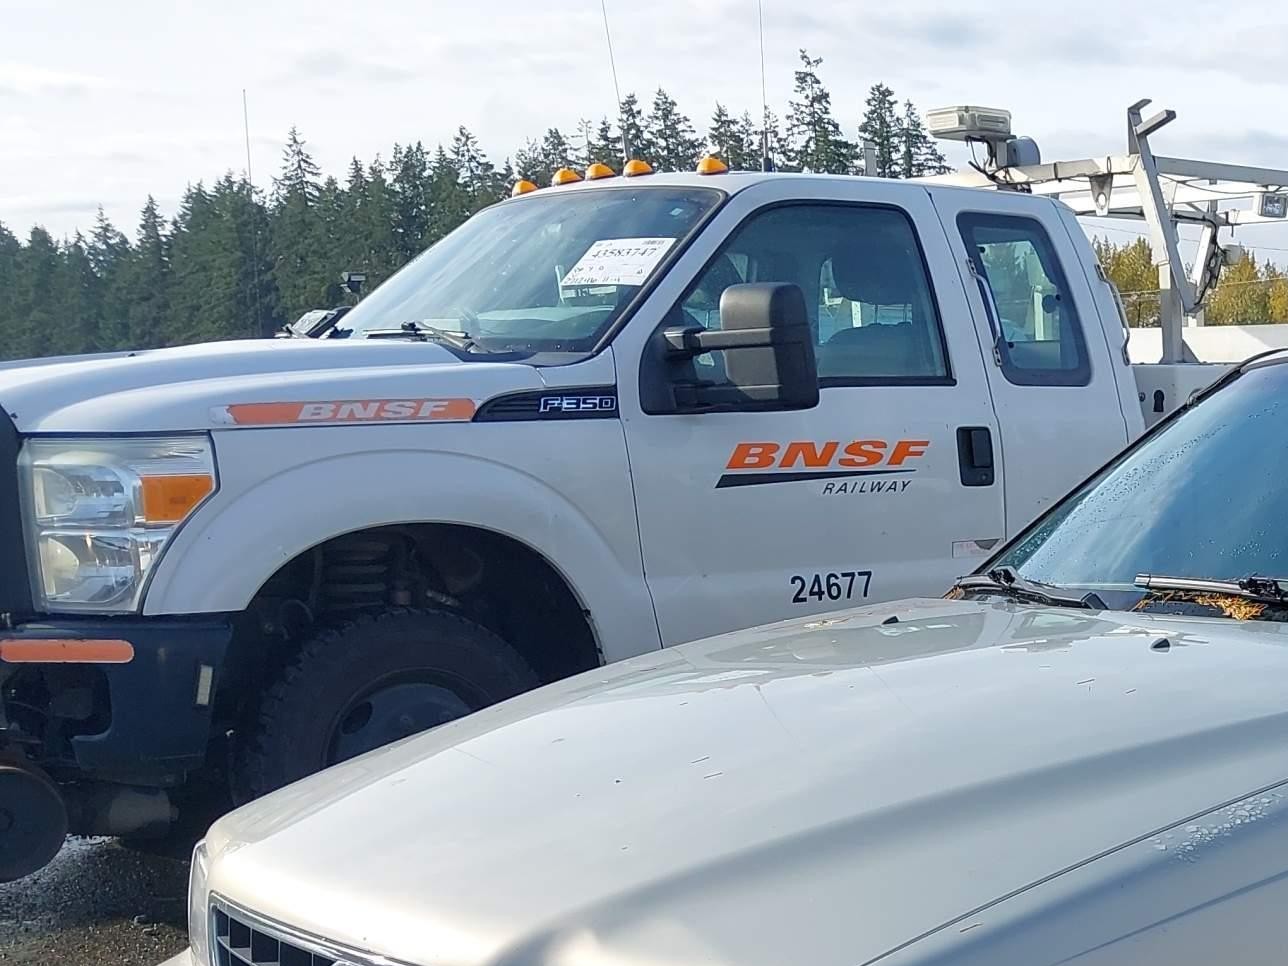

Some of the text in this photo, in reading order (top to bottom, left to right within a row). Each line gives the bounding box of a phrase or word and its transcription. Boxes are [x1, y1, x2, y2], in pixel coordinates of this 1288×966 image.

[297, 401, 448, 420] BNSF
[726, 440, 930, 469] BNSF
[822, 480, 912, 495] RAILWAY
[790, 571, 872, 603] 24677
